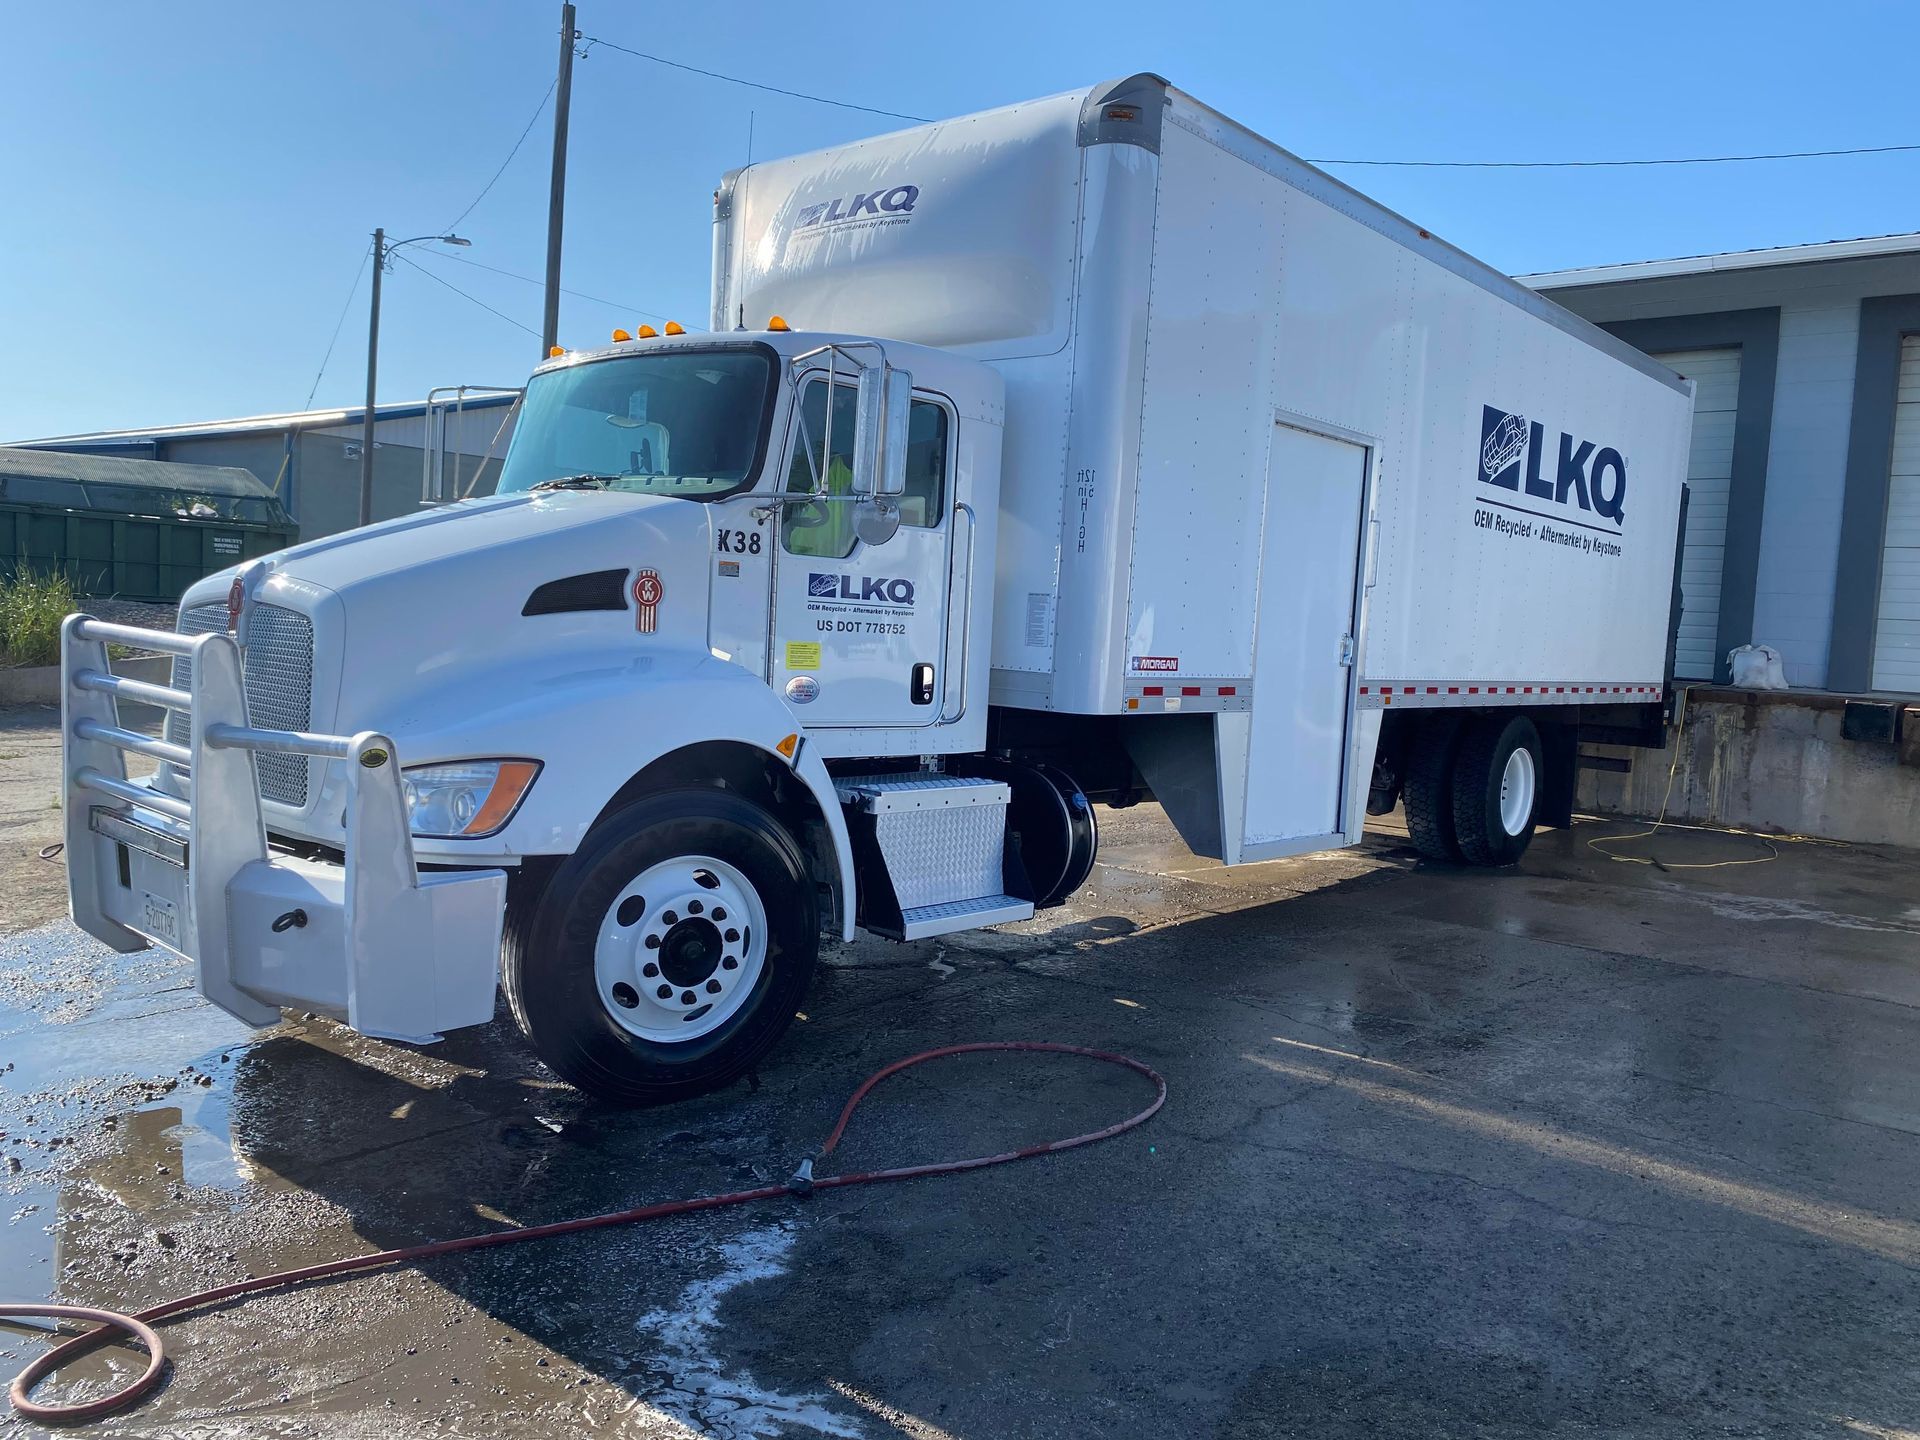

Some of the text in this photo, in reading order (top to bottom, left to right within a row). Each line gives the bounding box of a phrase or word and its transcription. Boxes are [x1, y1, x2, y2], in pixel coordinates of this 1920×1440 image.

[824, 185, 919, 221] LKQ
[869, 219, 878, 229] by
[878, 217, 911, 228] Keystone
[1525, 420, 1626, 527] LKQ
[1474, 508, 1622, 557] OEM Recycled Aftermarket by Keystone
[840, 574, 915, 606] LKQ
[821, 605, 847, 613] Recycled
[853, 607, 883, 615] Aftermarket
[884, 608, 891, 616] by
[891, 609, 915, 617] Keystone
[816, 620, 906, 635] US DOT 778752
[1140, 659, 1177, 670] MORGAN
